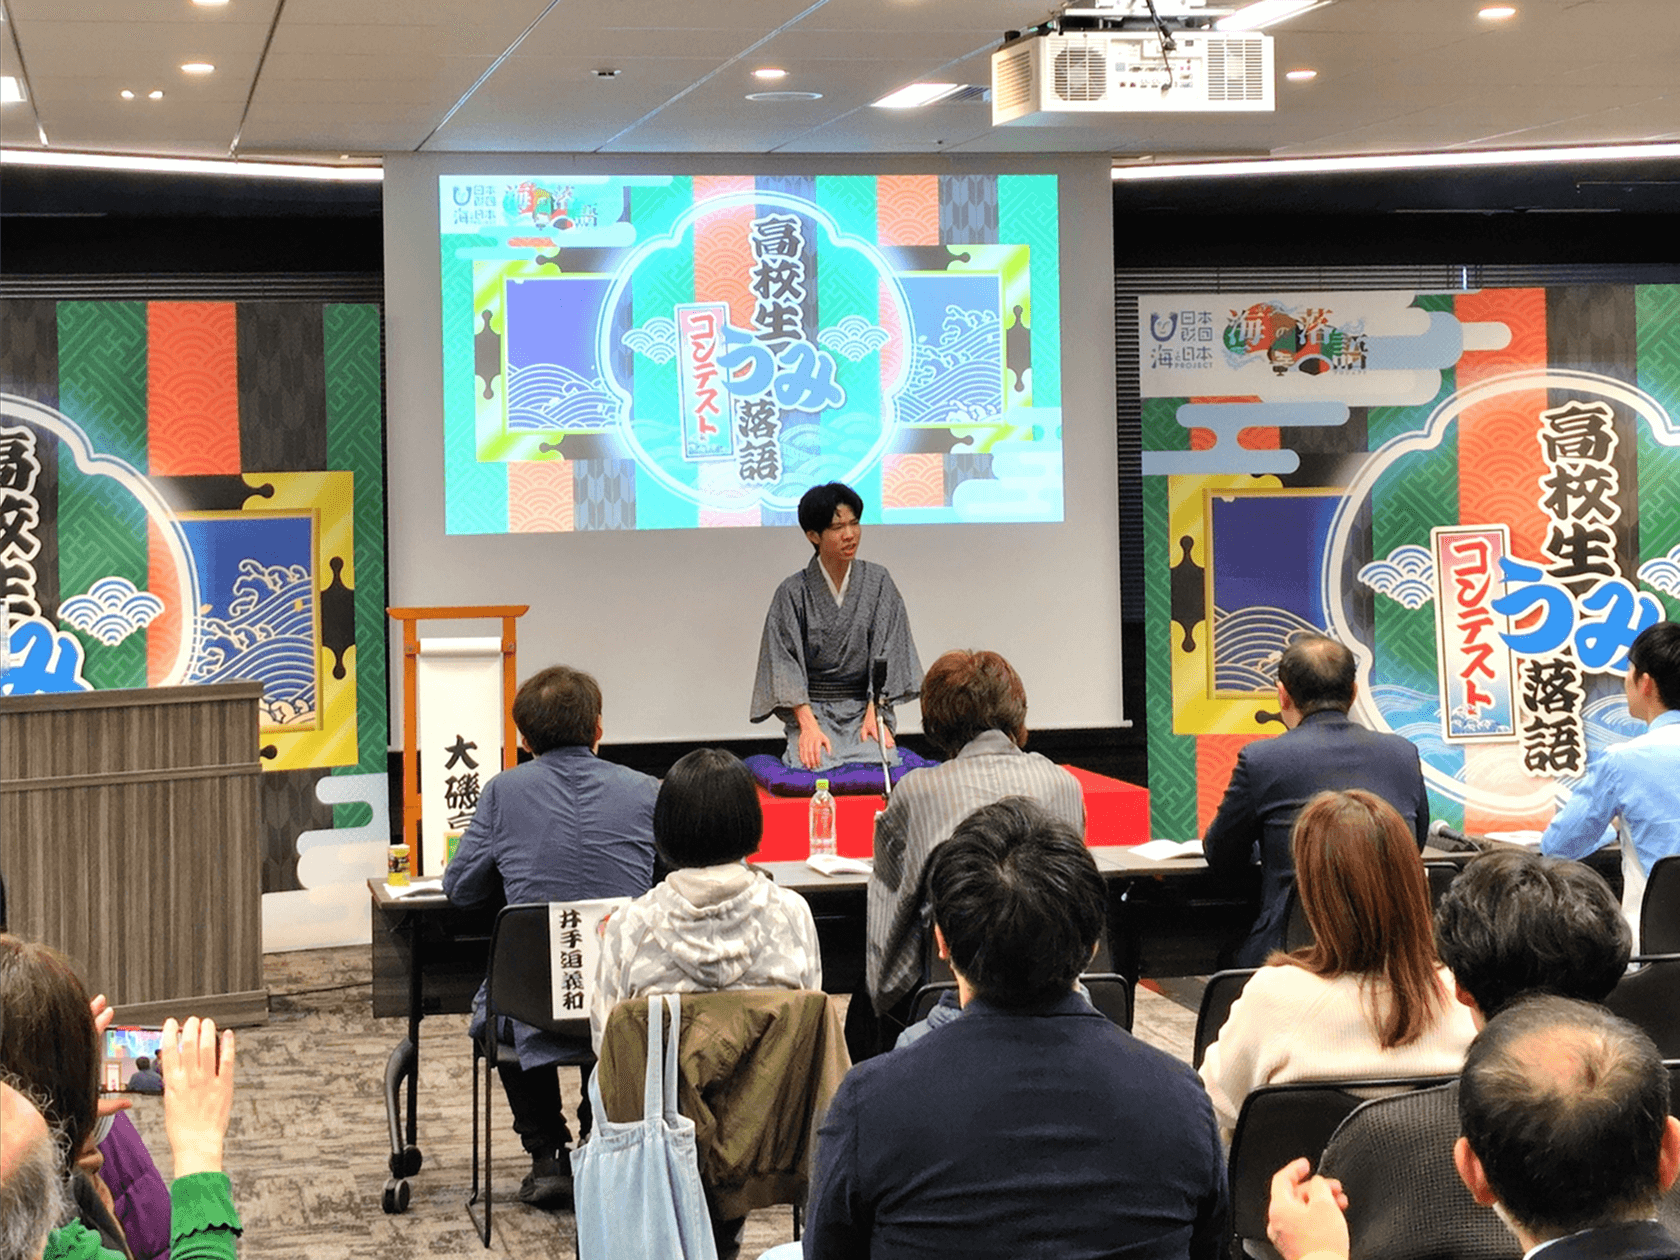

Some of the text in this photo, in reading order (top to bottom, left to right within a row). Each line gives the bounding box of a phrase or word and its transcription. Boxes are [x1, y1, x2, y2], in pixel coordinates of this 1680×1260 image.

[689, 314, 720, 435] コンテスト
[1453, 540, 1496, 715] コンテスト
